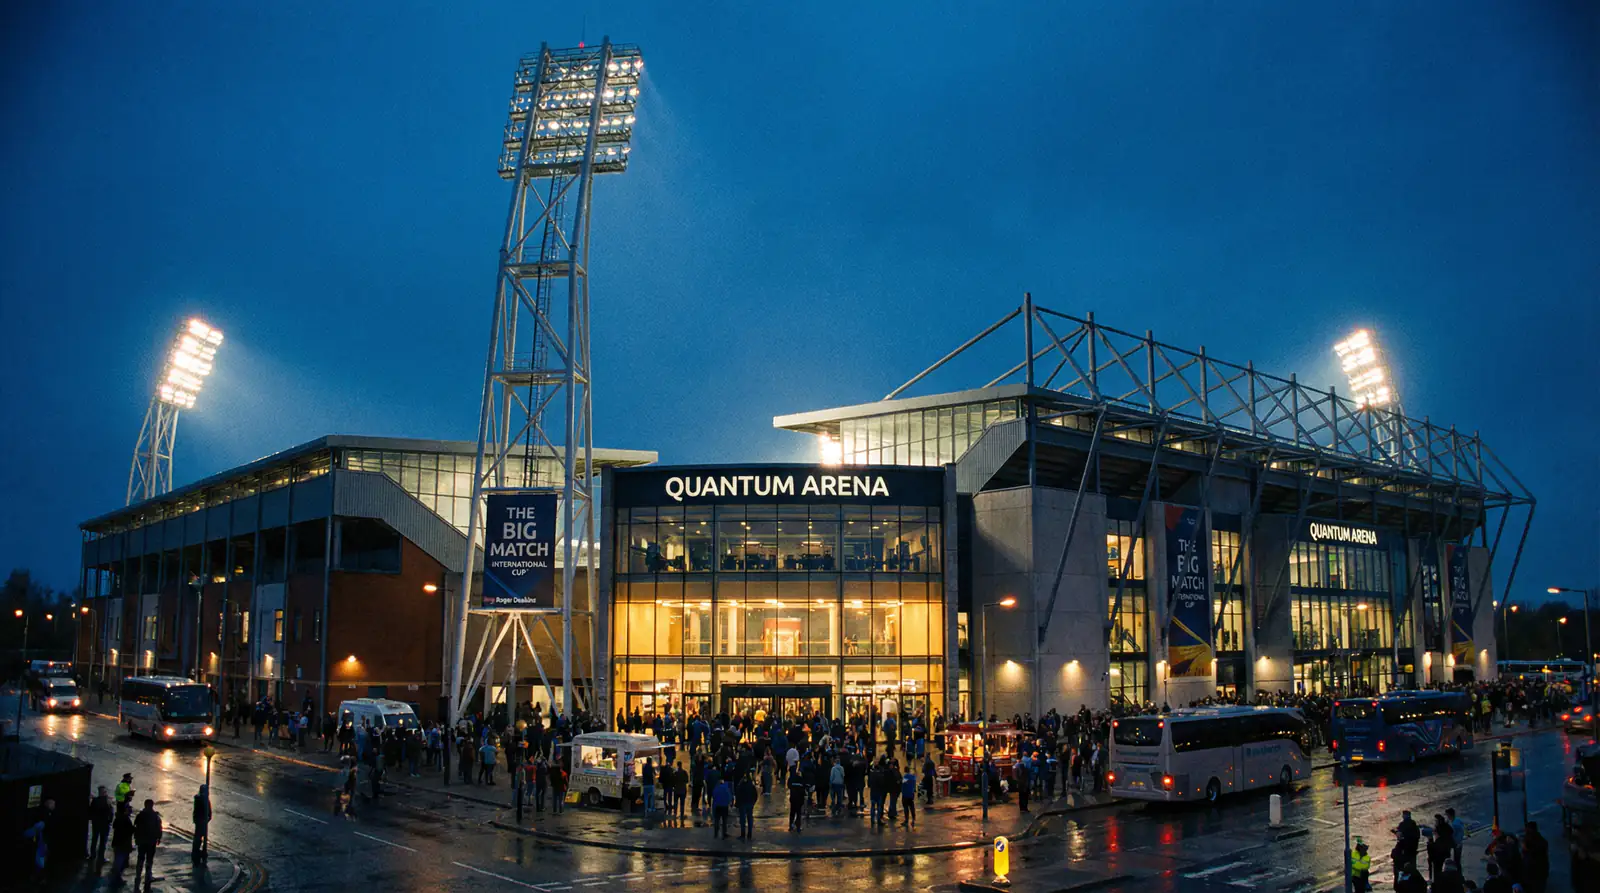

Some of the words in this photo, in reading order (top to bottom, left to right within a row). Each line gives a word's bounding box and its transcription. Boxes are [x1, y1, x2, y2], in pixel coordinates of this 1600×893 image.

[665, 476, 795, 501] QUANTUM
[801, 475, 890, 496] ARENA
[506, 507, 536, 519] THE
[503, 522, 537, 540] BIG
[1310, 522, 1351, 541] QUANTUM
[1351, 528, 1378, 545] ARENA
[490, 542, 549, 557] MATCH
[491, 560, 548, 568] INTERNATIONAL
